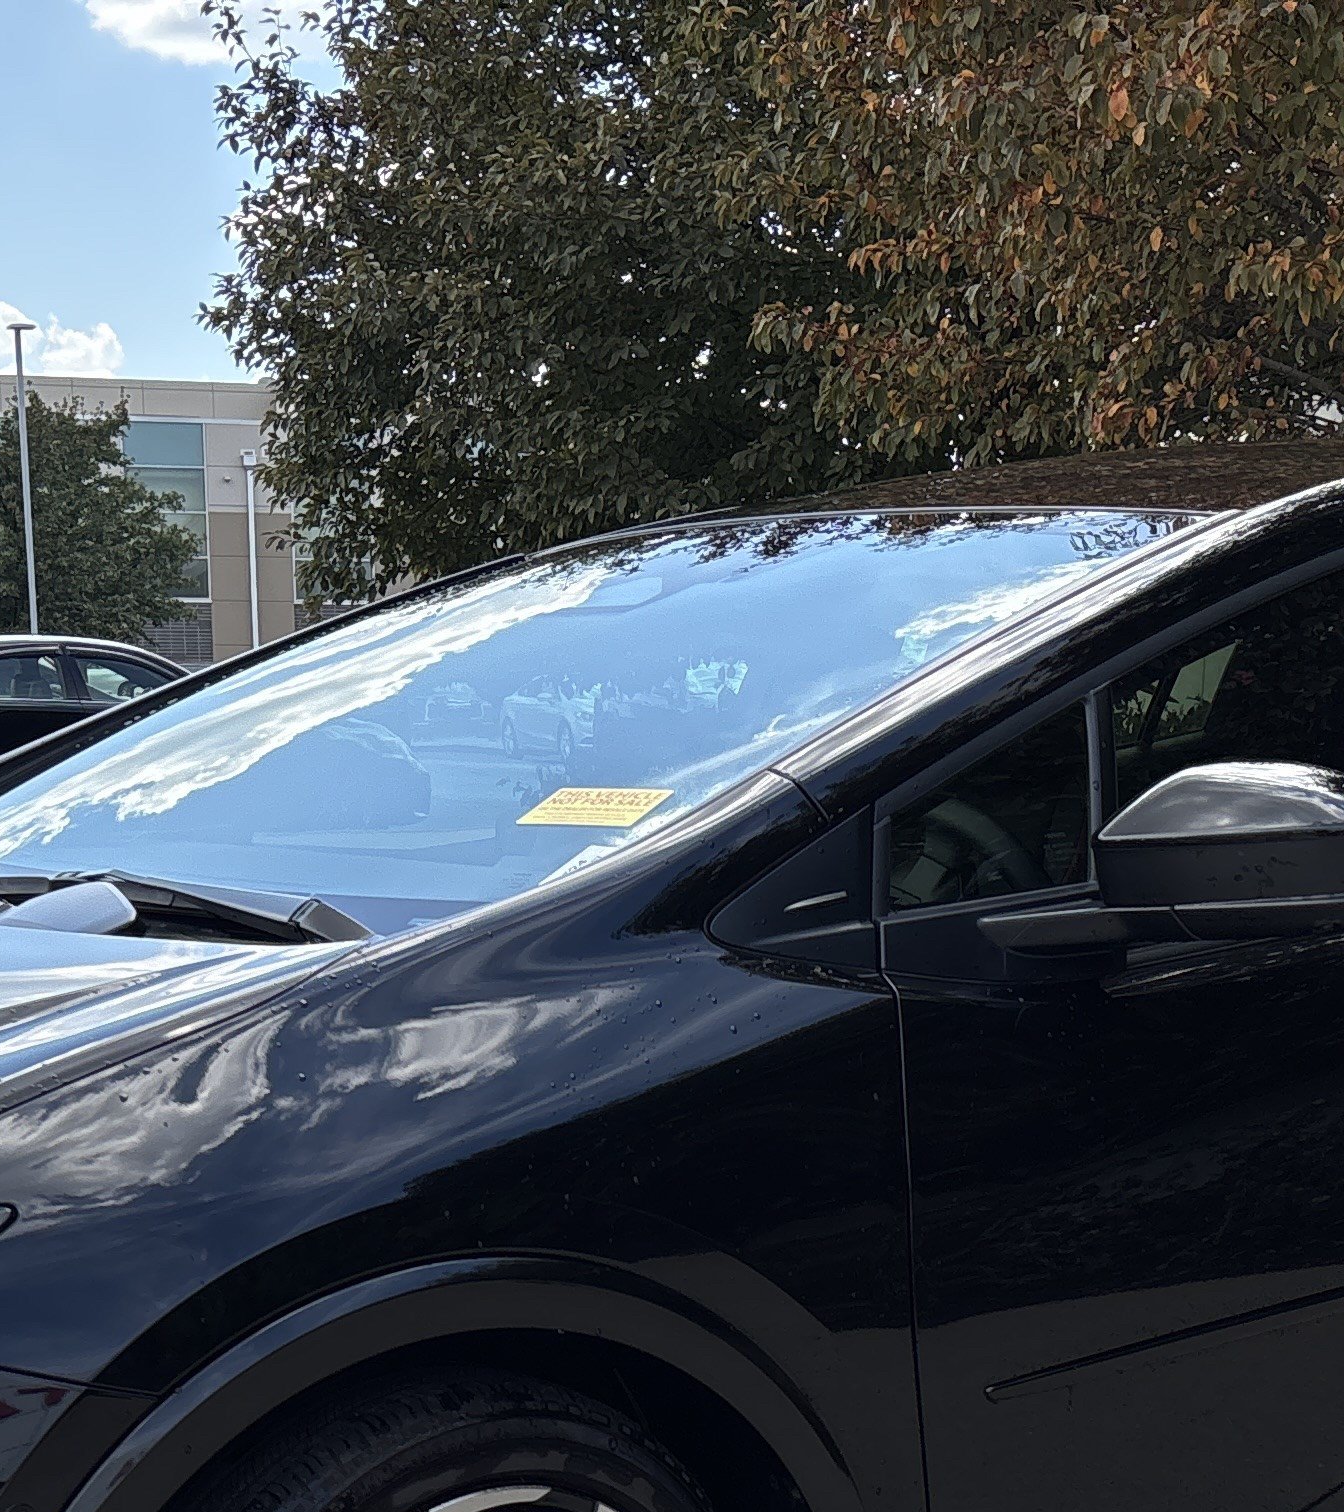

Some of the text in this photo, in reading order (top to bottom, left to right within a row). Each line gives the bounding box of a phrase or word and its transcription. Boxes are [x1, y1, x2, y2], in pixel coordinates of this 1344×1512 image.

[556, 790, 666, 801] THIS VEHICLE
[580, 798, 615, 806] FOR
[614, 799, 655, 807] SALE
